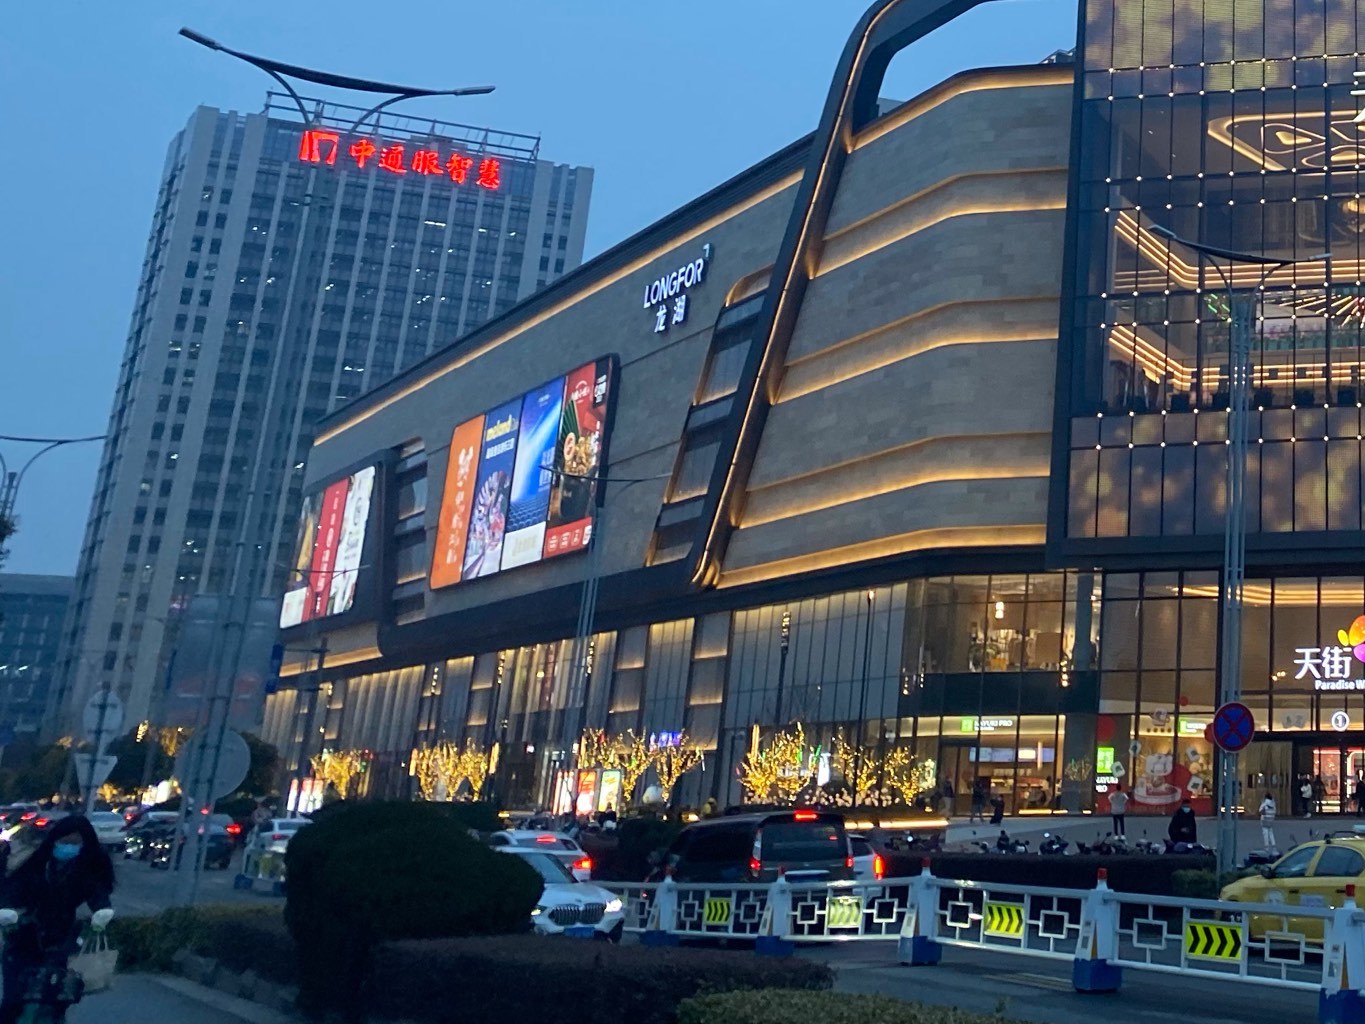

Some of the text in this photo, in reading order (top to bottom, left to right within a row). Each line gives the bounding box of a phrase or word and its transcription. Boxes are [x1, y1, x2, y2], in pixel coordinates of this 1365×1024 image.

[349, 138, 501, 190] 中通服智慧
[643, 258, 704, 309] LONGFOR
[654, 294, 686, 333] 龙湖
[1293, 646, 1352, 679] 天街
[1315, 679, 1355, 690] Paradise
